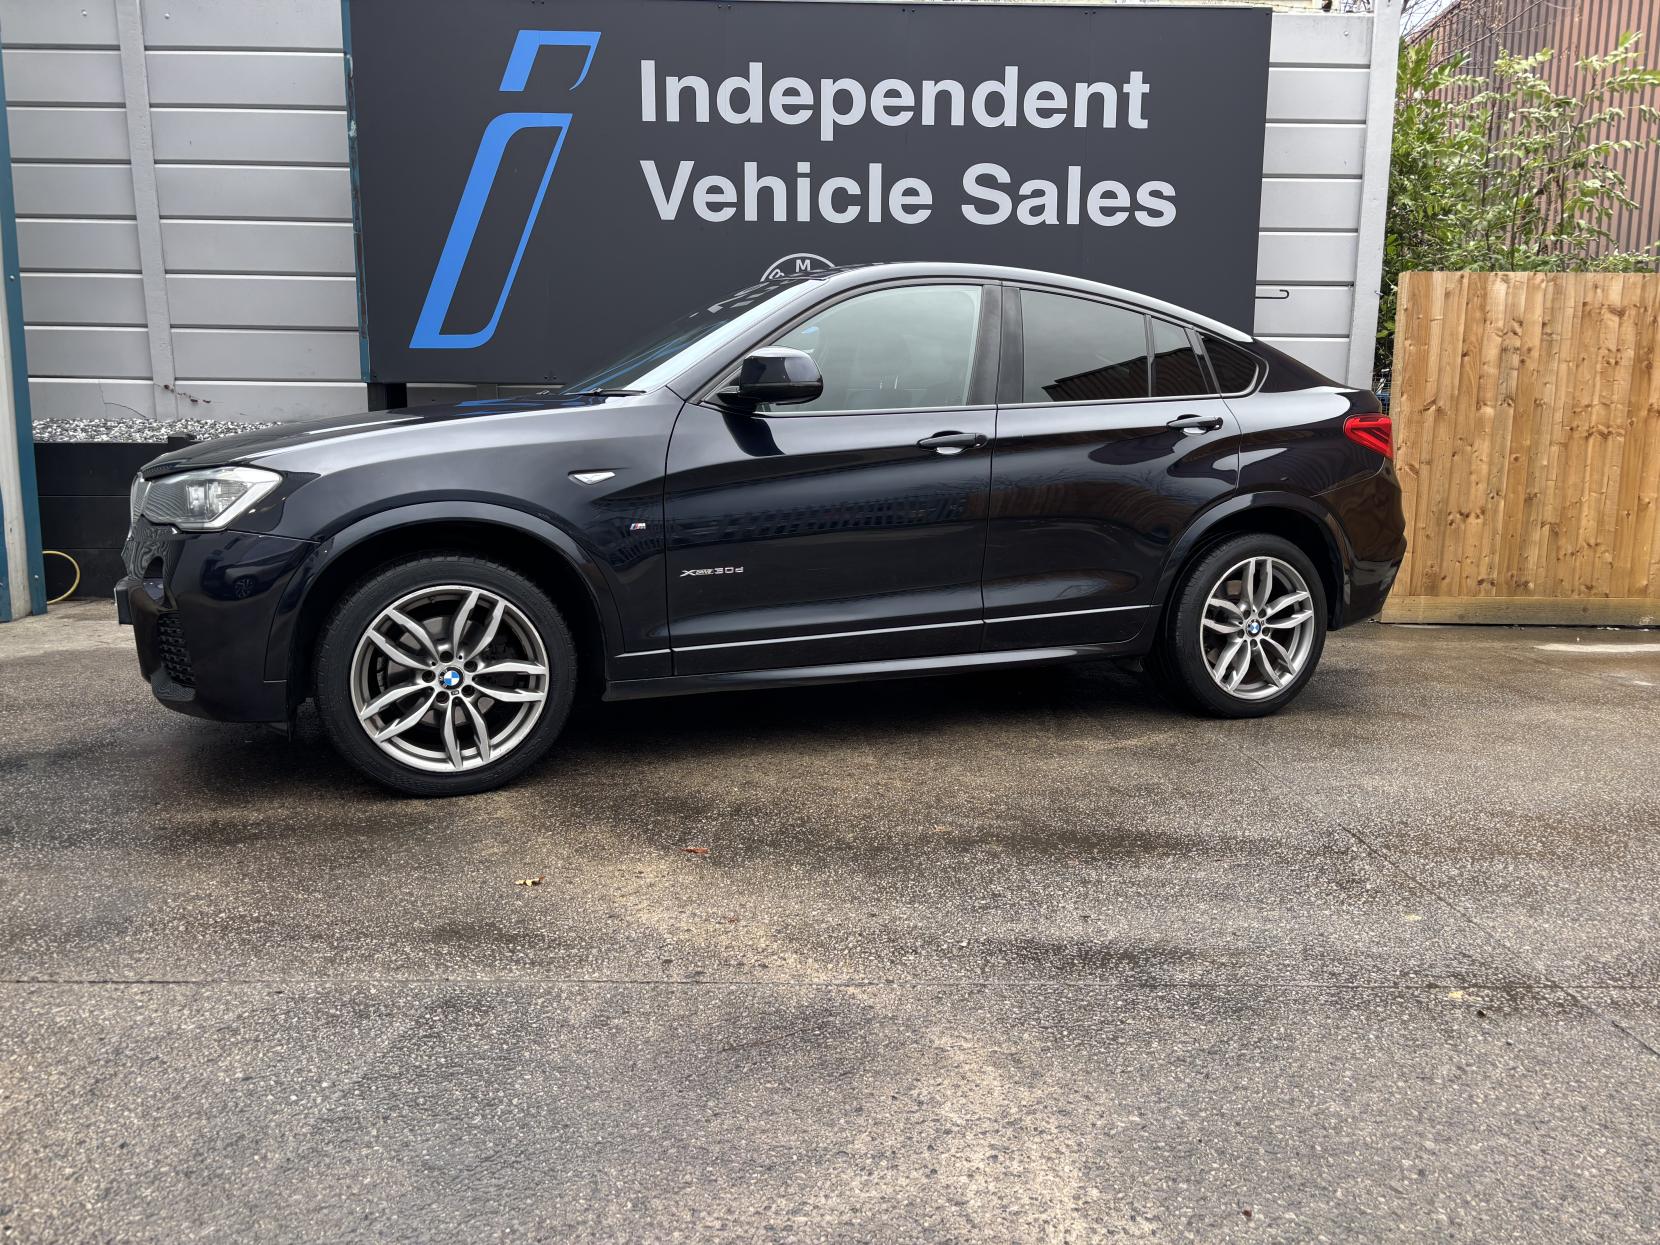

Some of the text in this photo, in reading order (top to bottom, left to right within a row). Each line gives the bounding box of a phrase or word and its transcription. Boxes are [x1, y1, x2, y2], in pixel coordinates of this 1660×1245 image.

[640, 59, 1150, 142] Independent
[639, 160, 1177, 228] Vehicle Sales
